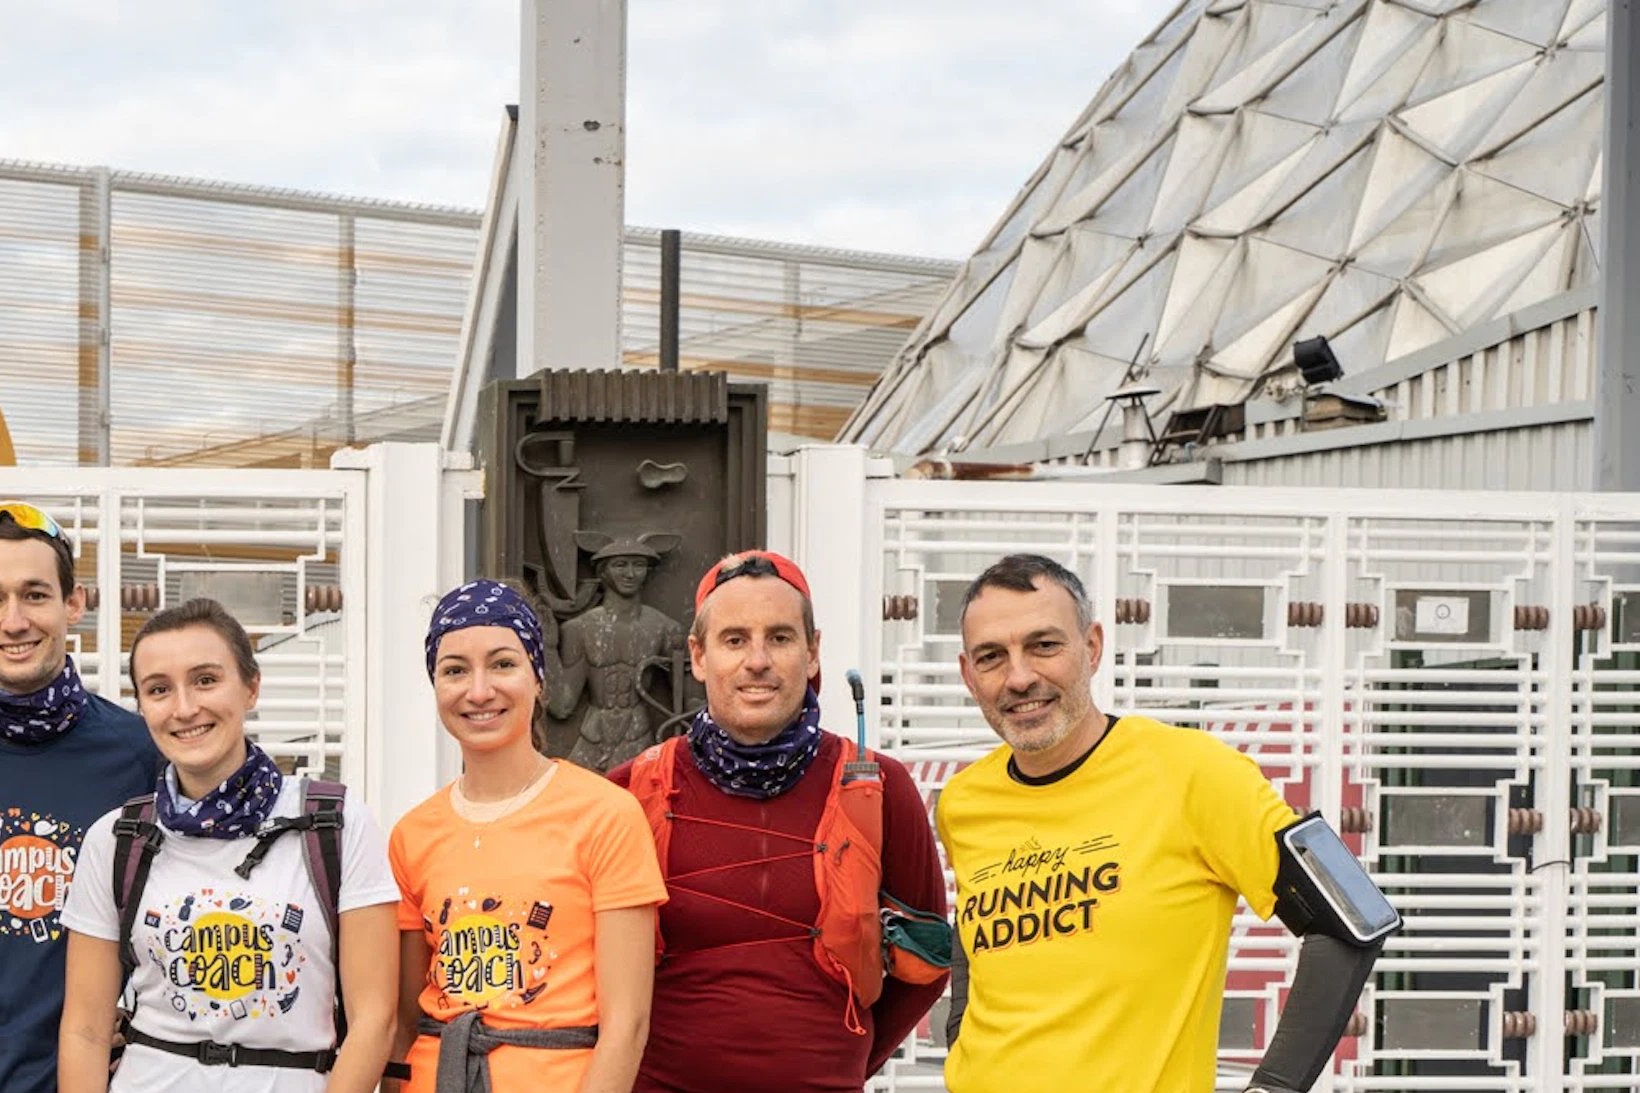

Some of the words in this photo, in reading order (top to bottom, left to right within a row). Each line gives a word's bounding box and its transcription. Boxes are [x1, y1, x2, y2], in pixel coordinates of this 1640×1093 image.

[1002, 845, 1070, 877] happy
[962, 862, 1120, 925] RUNNING
[439, 923, 521, 956] ampus
[973, 898, 1098, 954] ADDICT
